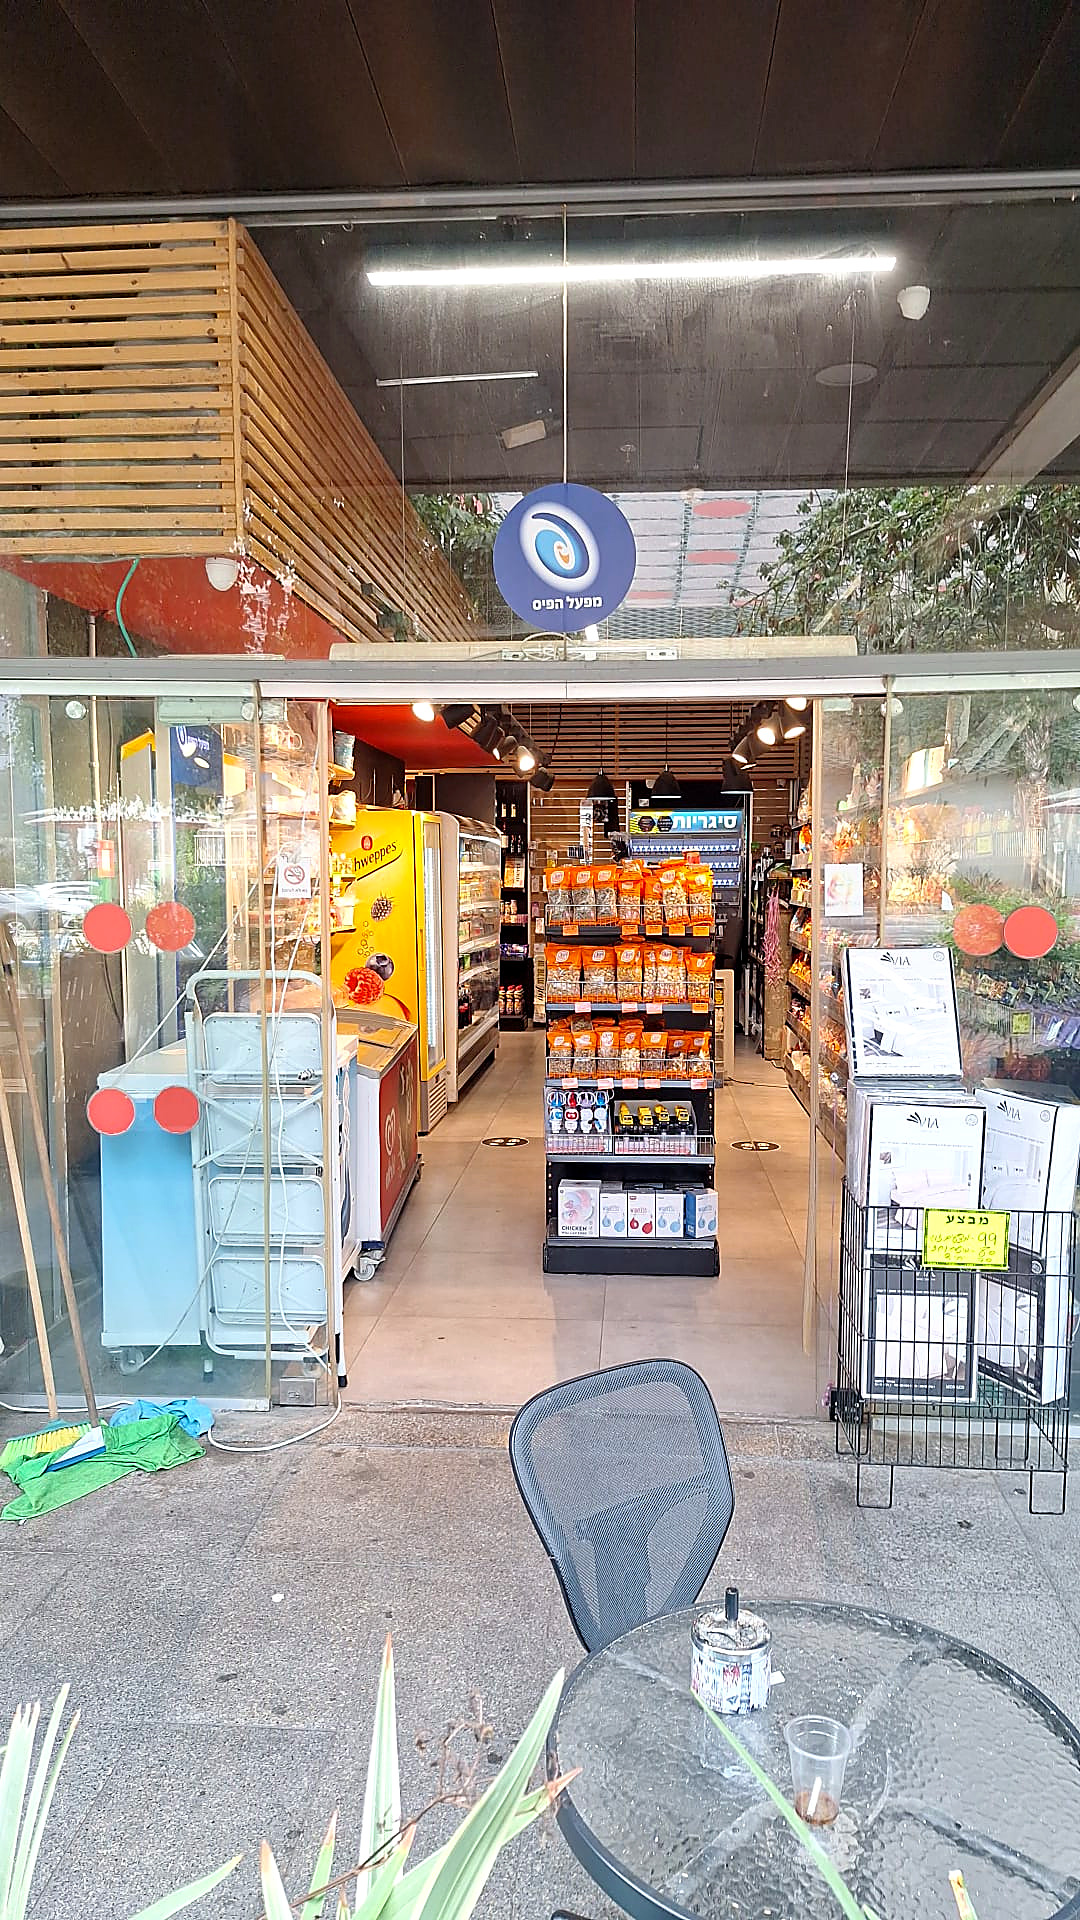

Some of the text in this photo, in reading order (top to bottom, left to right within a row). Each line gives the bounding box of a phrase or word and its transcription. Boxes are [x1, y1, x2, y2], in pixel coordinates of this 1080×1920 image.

[532, 596, 602, 611] מפעל הפיס
[672, 815, 738, 829] סיגריות
[353, 840, 399, 871] hweppes
[945, 1215, 989, 1225] מבצע
